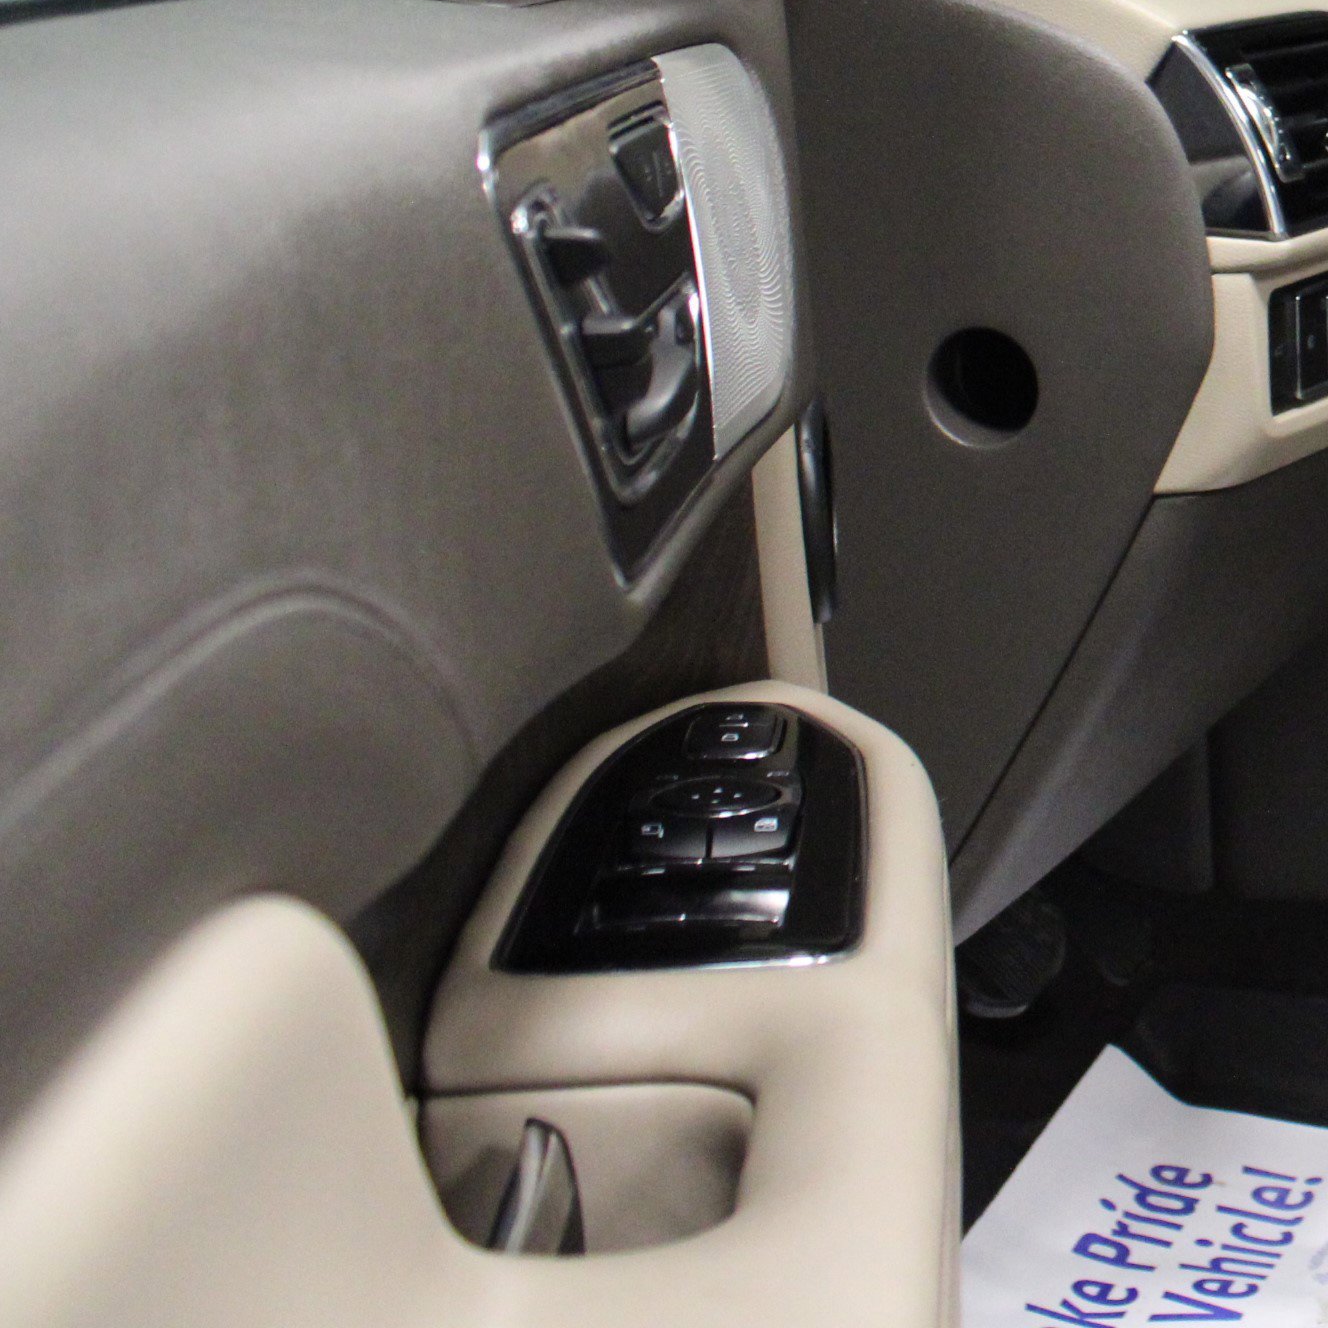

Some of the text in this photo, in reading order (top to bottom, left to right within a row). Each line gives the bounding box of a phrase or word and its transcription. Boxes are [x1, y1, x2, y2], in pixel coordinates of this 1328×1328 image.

[1025, 1164, 1213, 1328] ke Pride
[1147, 1165, 1324, 1322] Vehicle!
